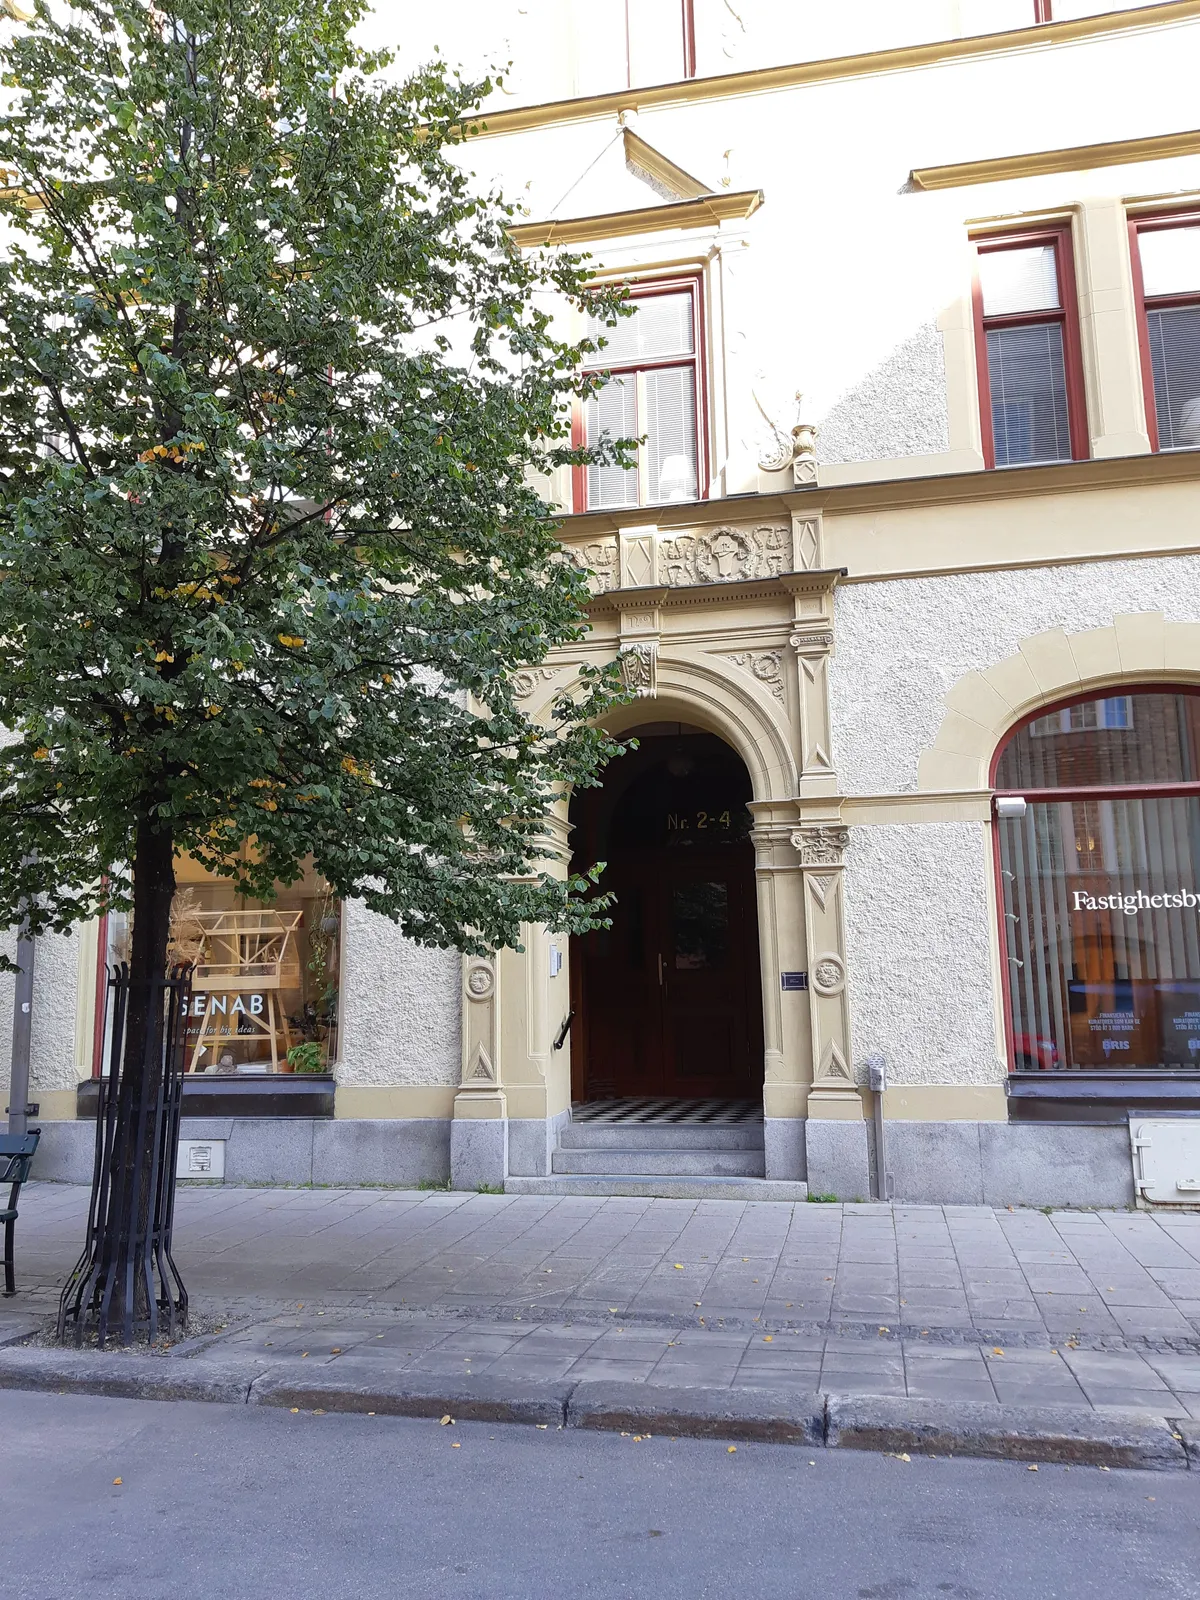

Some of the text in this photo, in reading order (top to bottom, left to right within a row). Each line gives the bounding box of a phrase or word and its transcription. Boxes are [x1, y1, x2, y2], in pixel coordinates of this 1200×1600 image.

[667, 810, 732, 830] Nr. 2-4
[205, 1025, 217, 1036] for
[220, 1025, 232, 1036] big
[234, 1024, 256, 1034] ideas
[1102, 1040, 1130, 1050] BRIS
